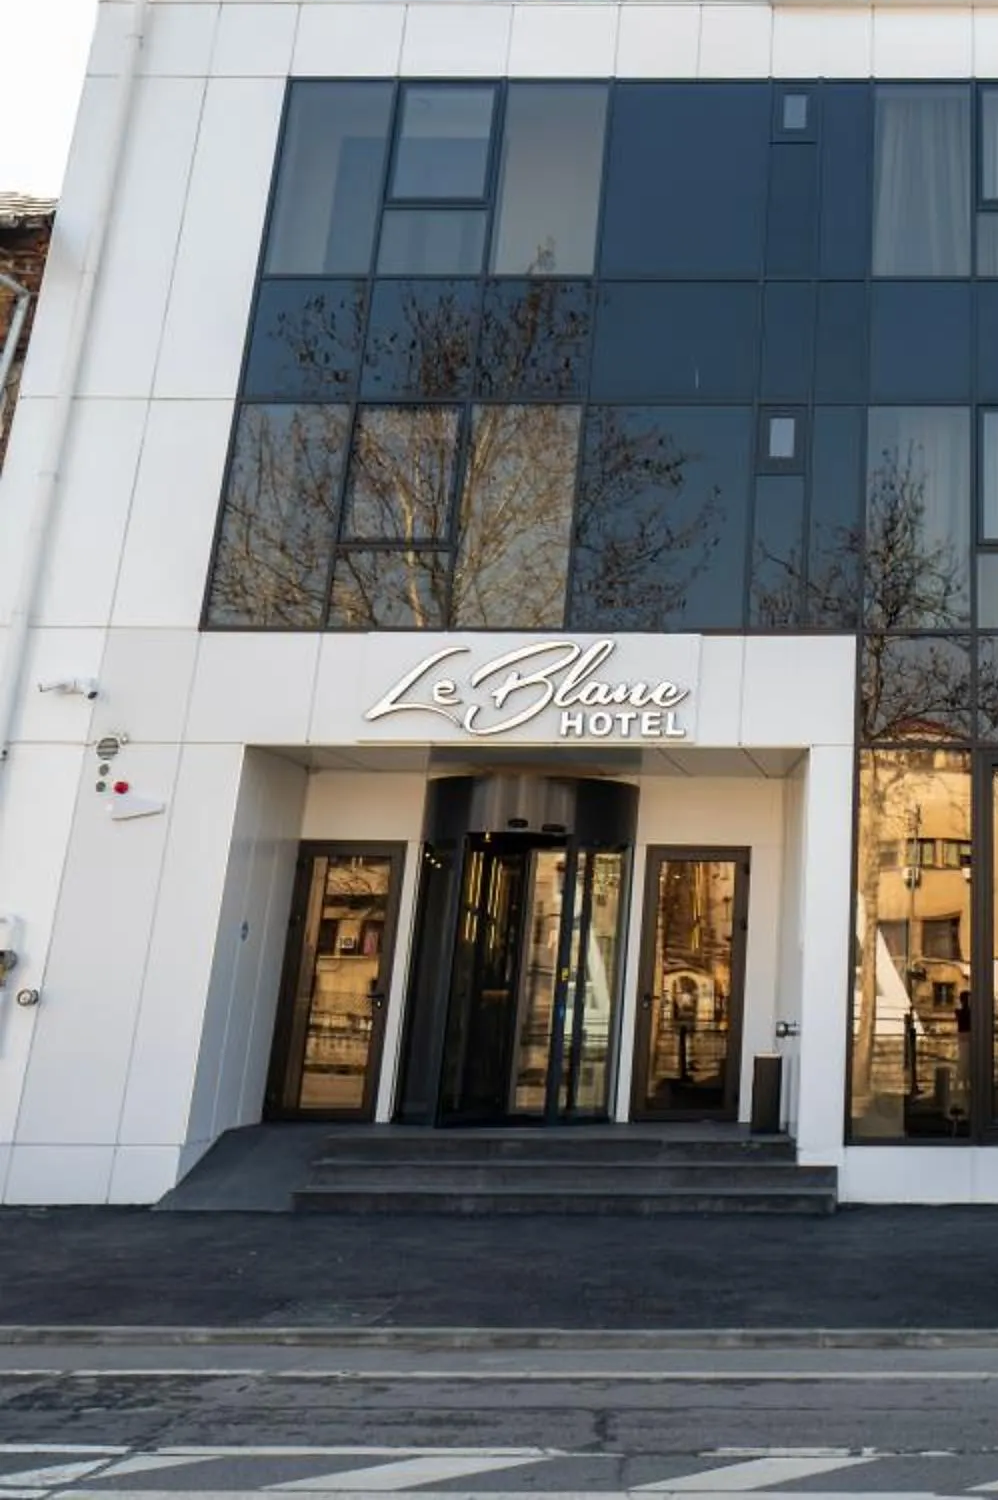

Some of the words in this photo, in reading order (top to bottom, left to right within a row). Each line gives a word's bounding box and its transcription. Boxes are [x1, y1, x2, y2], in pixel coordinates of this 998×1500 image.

[363, 647, 471, 728] Le
[463, 639, 690, 735] Blanc
[560, 711, 687, 738] HOTEL
